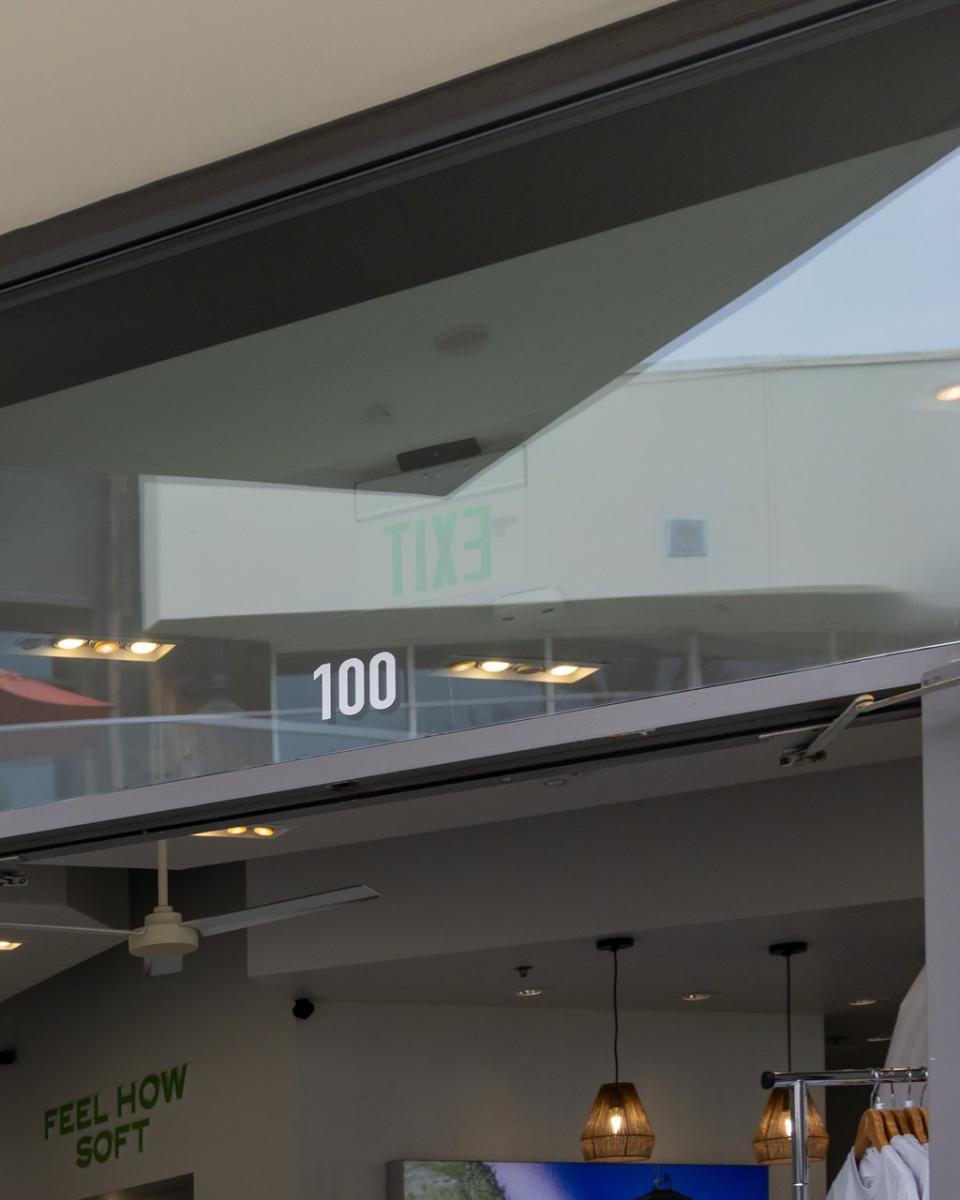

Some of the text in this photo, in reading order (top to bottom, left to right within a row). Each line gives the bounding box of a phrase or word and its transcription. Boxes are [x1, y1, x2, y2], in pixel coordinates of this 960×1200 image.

[313, 651, 396, 721] 100
[44, 1063, 189, 1139] FEEL HOW
[76, 1118, 151, 1168] SOFT
